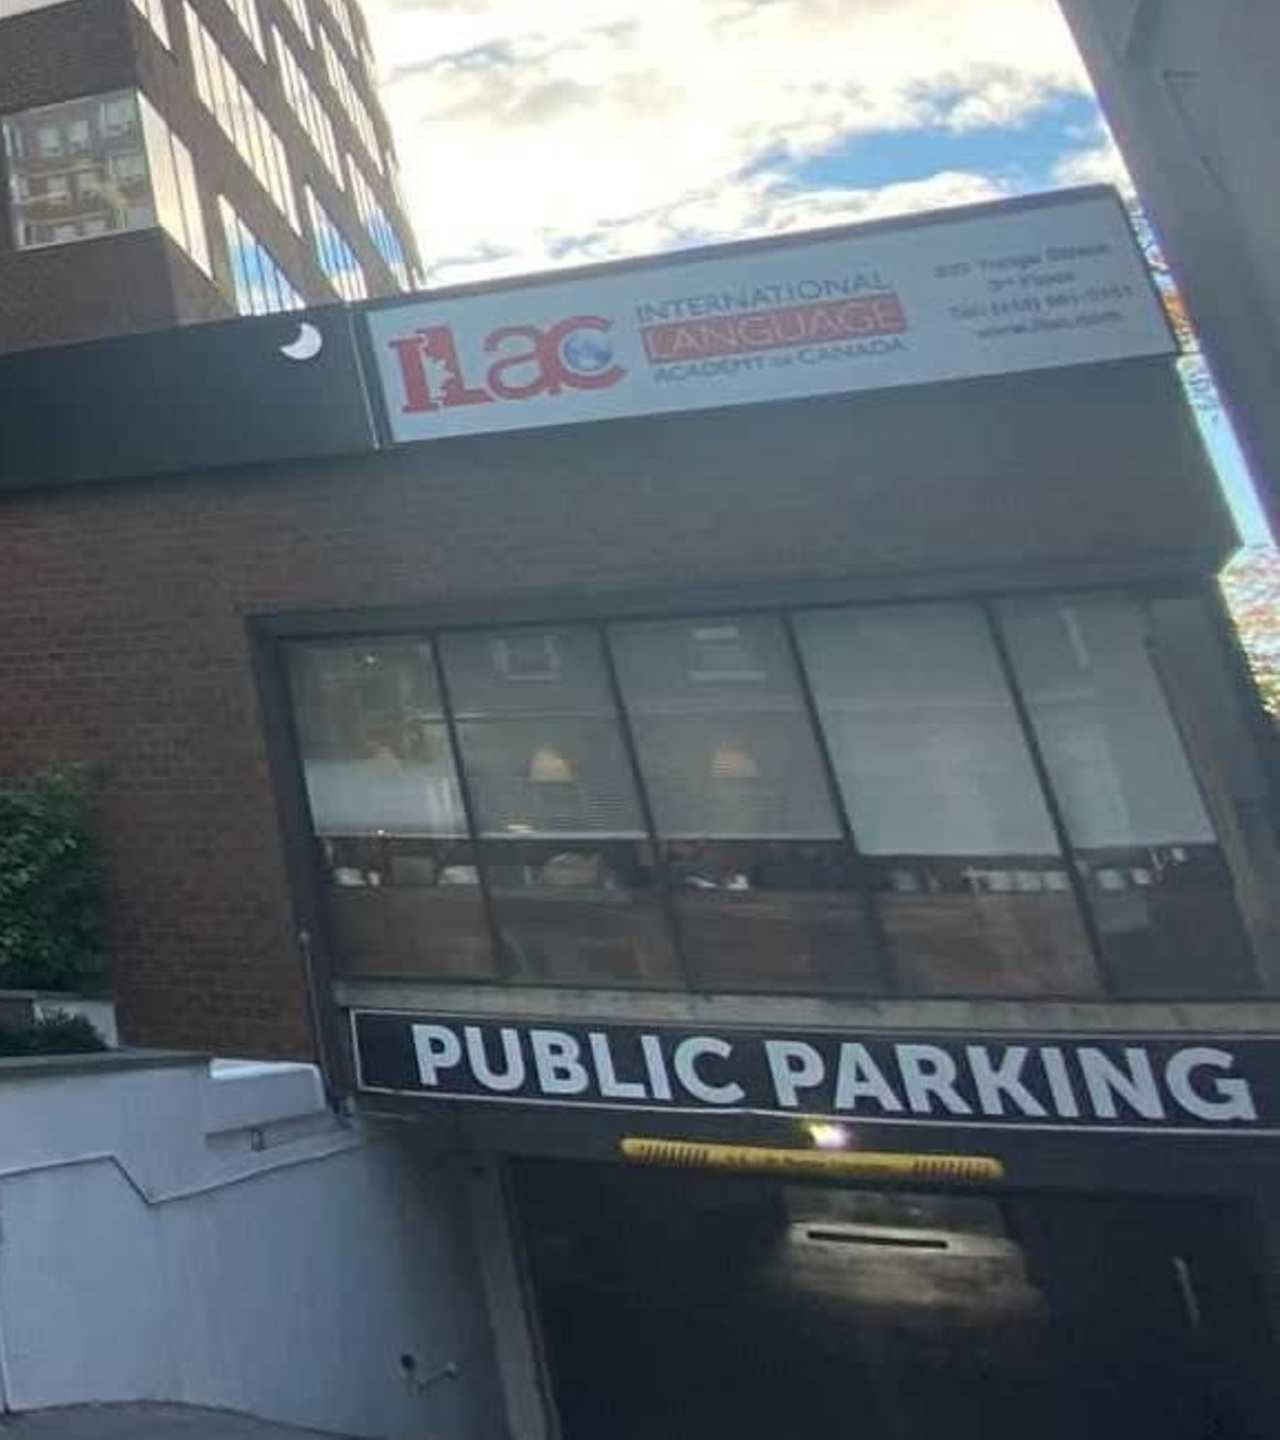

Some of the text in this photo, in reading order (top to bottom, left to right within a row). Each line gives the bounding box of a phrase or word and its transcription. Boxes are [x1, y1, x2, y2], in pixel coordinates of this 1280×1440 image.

[635, 270, 892, 321] INTERNATIONAL
[646, 301, 900, 358] LANGUAGE
[798, 337, 911, 365] CANADA
[411, 1023, 1259, 1122] PUBLIC PARKING
